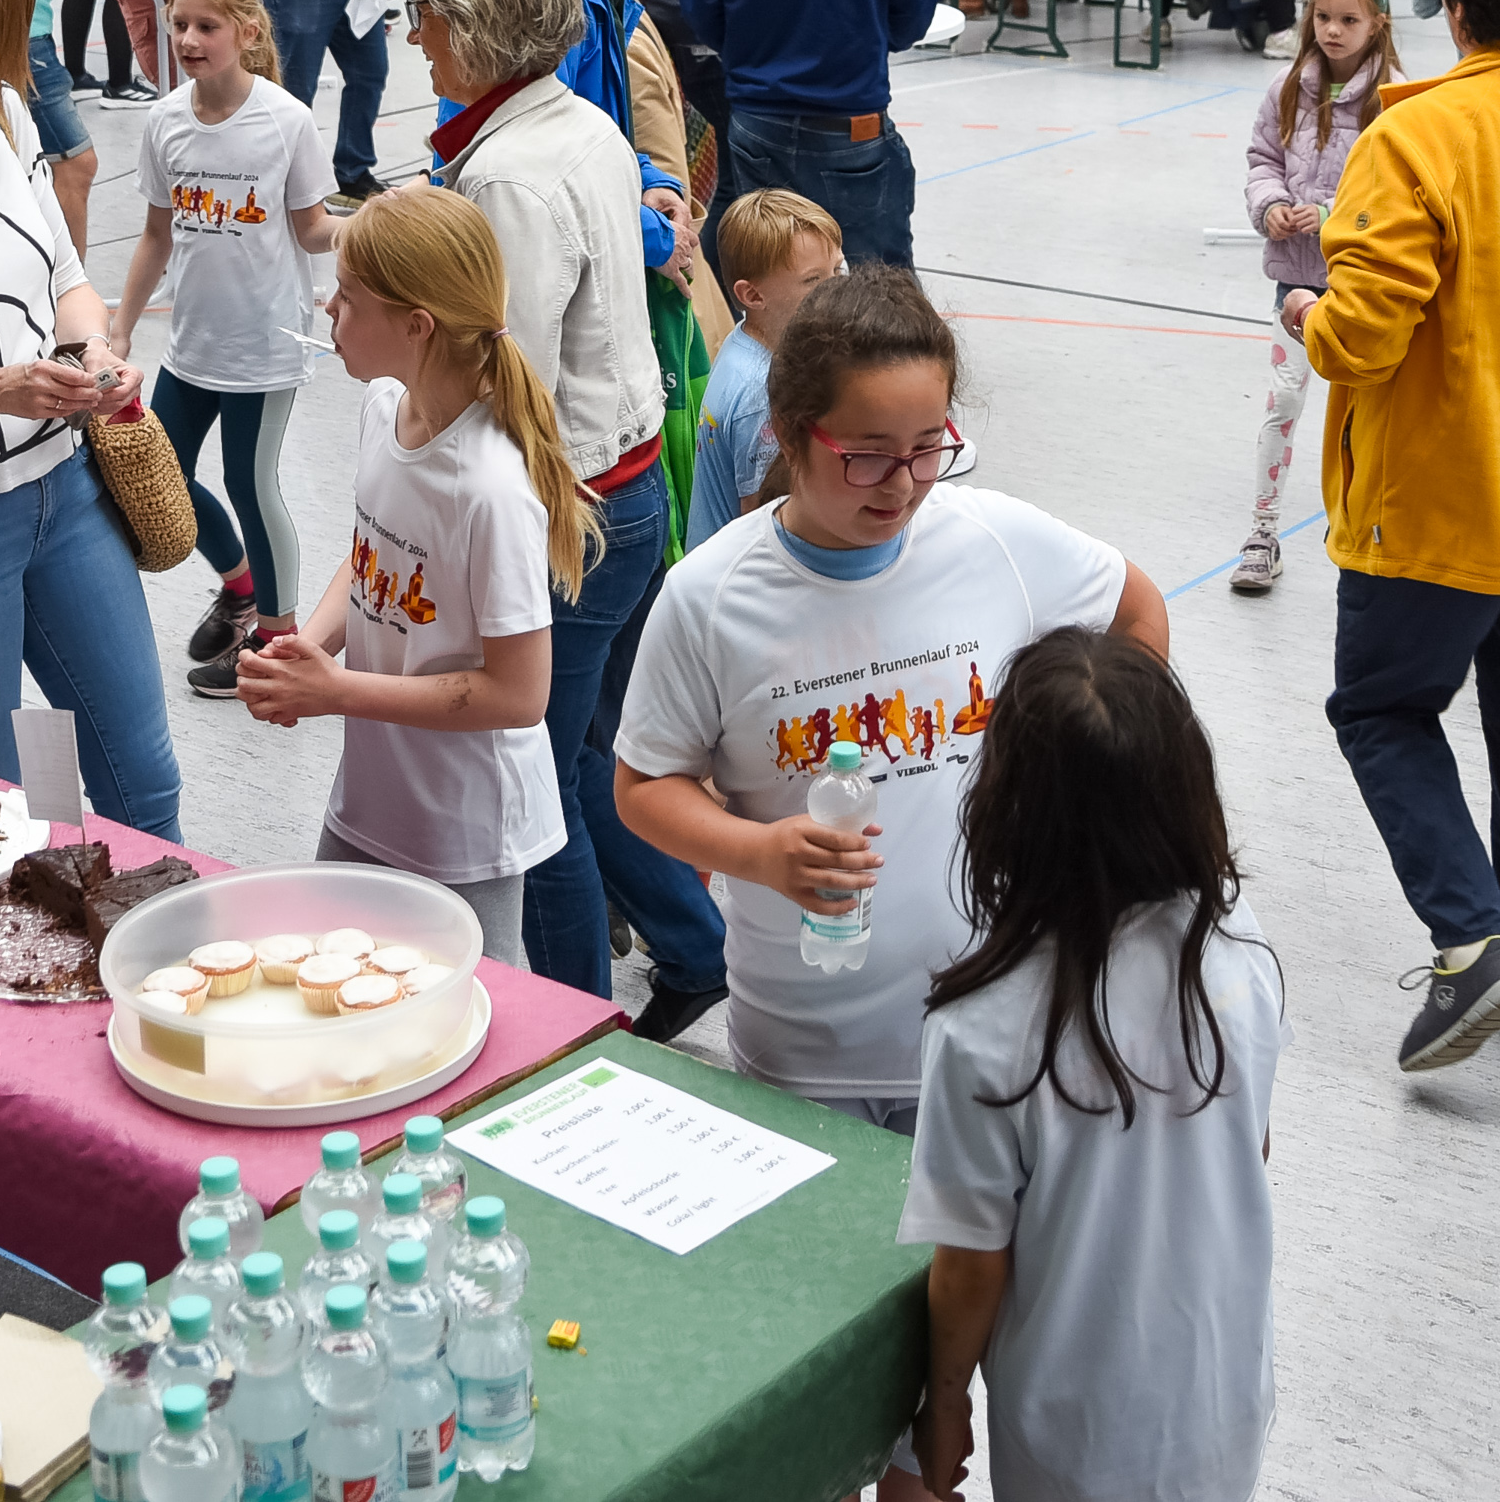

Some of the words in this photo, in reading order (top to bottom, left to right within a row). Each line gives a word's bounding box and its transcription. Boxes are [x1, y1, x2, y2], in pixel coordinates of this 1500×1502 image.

[201, 170, 242, 181] Brunnenlauf
[243, 174, 259, 182] 2024
[99, 373, 111, 382] 5
[408, 543, 428, 560] 2024
[771, 686, 790, 700] 22.
[794, 667, 867, 696] Everstener
[870, 644, 951, 677] Brunnenlauf
[955, 639, 980, 657] 2024
[896, 762, 938, 778] VIEROL
[511, 1081, 580, 1120] EVERSTENER
[523, 1087, 589, 1126] BRUNNENLAUF
[532, 1144, 570, 1166] Kuchen
[622, 1101, 645, 1117] 2,00
[541, 1103, 604, 1140] Preisliste
[553, 1153, 591, 1176] Kuchen
[644, 1111, 667, 1127] 1,00
[576, 1165, 609, 1186] Kaffee
[666, 1120, 688, 1136] 1,50
[597, 1182, 619, 1196] Tee
[688, 1129, 711, 1145] 1,00
[620, 1169, 681, 1208] Apfelschorle
[711, 1139, 733, 1155] 1,50
[642, 1193, 680, 1217] Wasser
[733, 1149, 756, 1165] 1,00
[756, 1158, 779, 1174] 2,00
